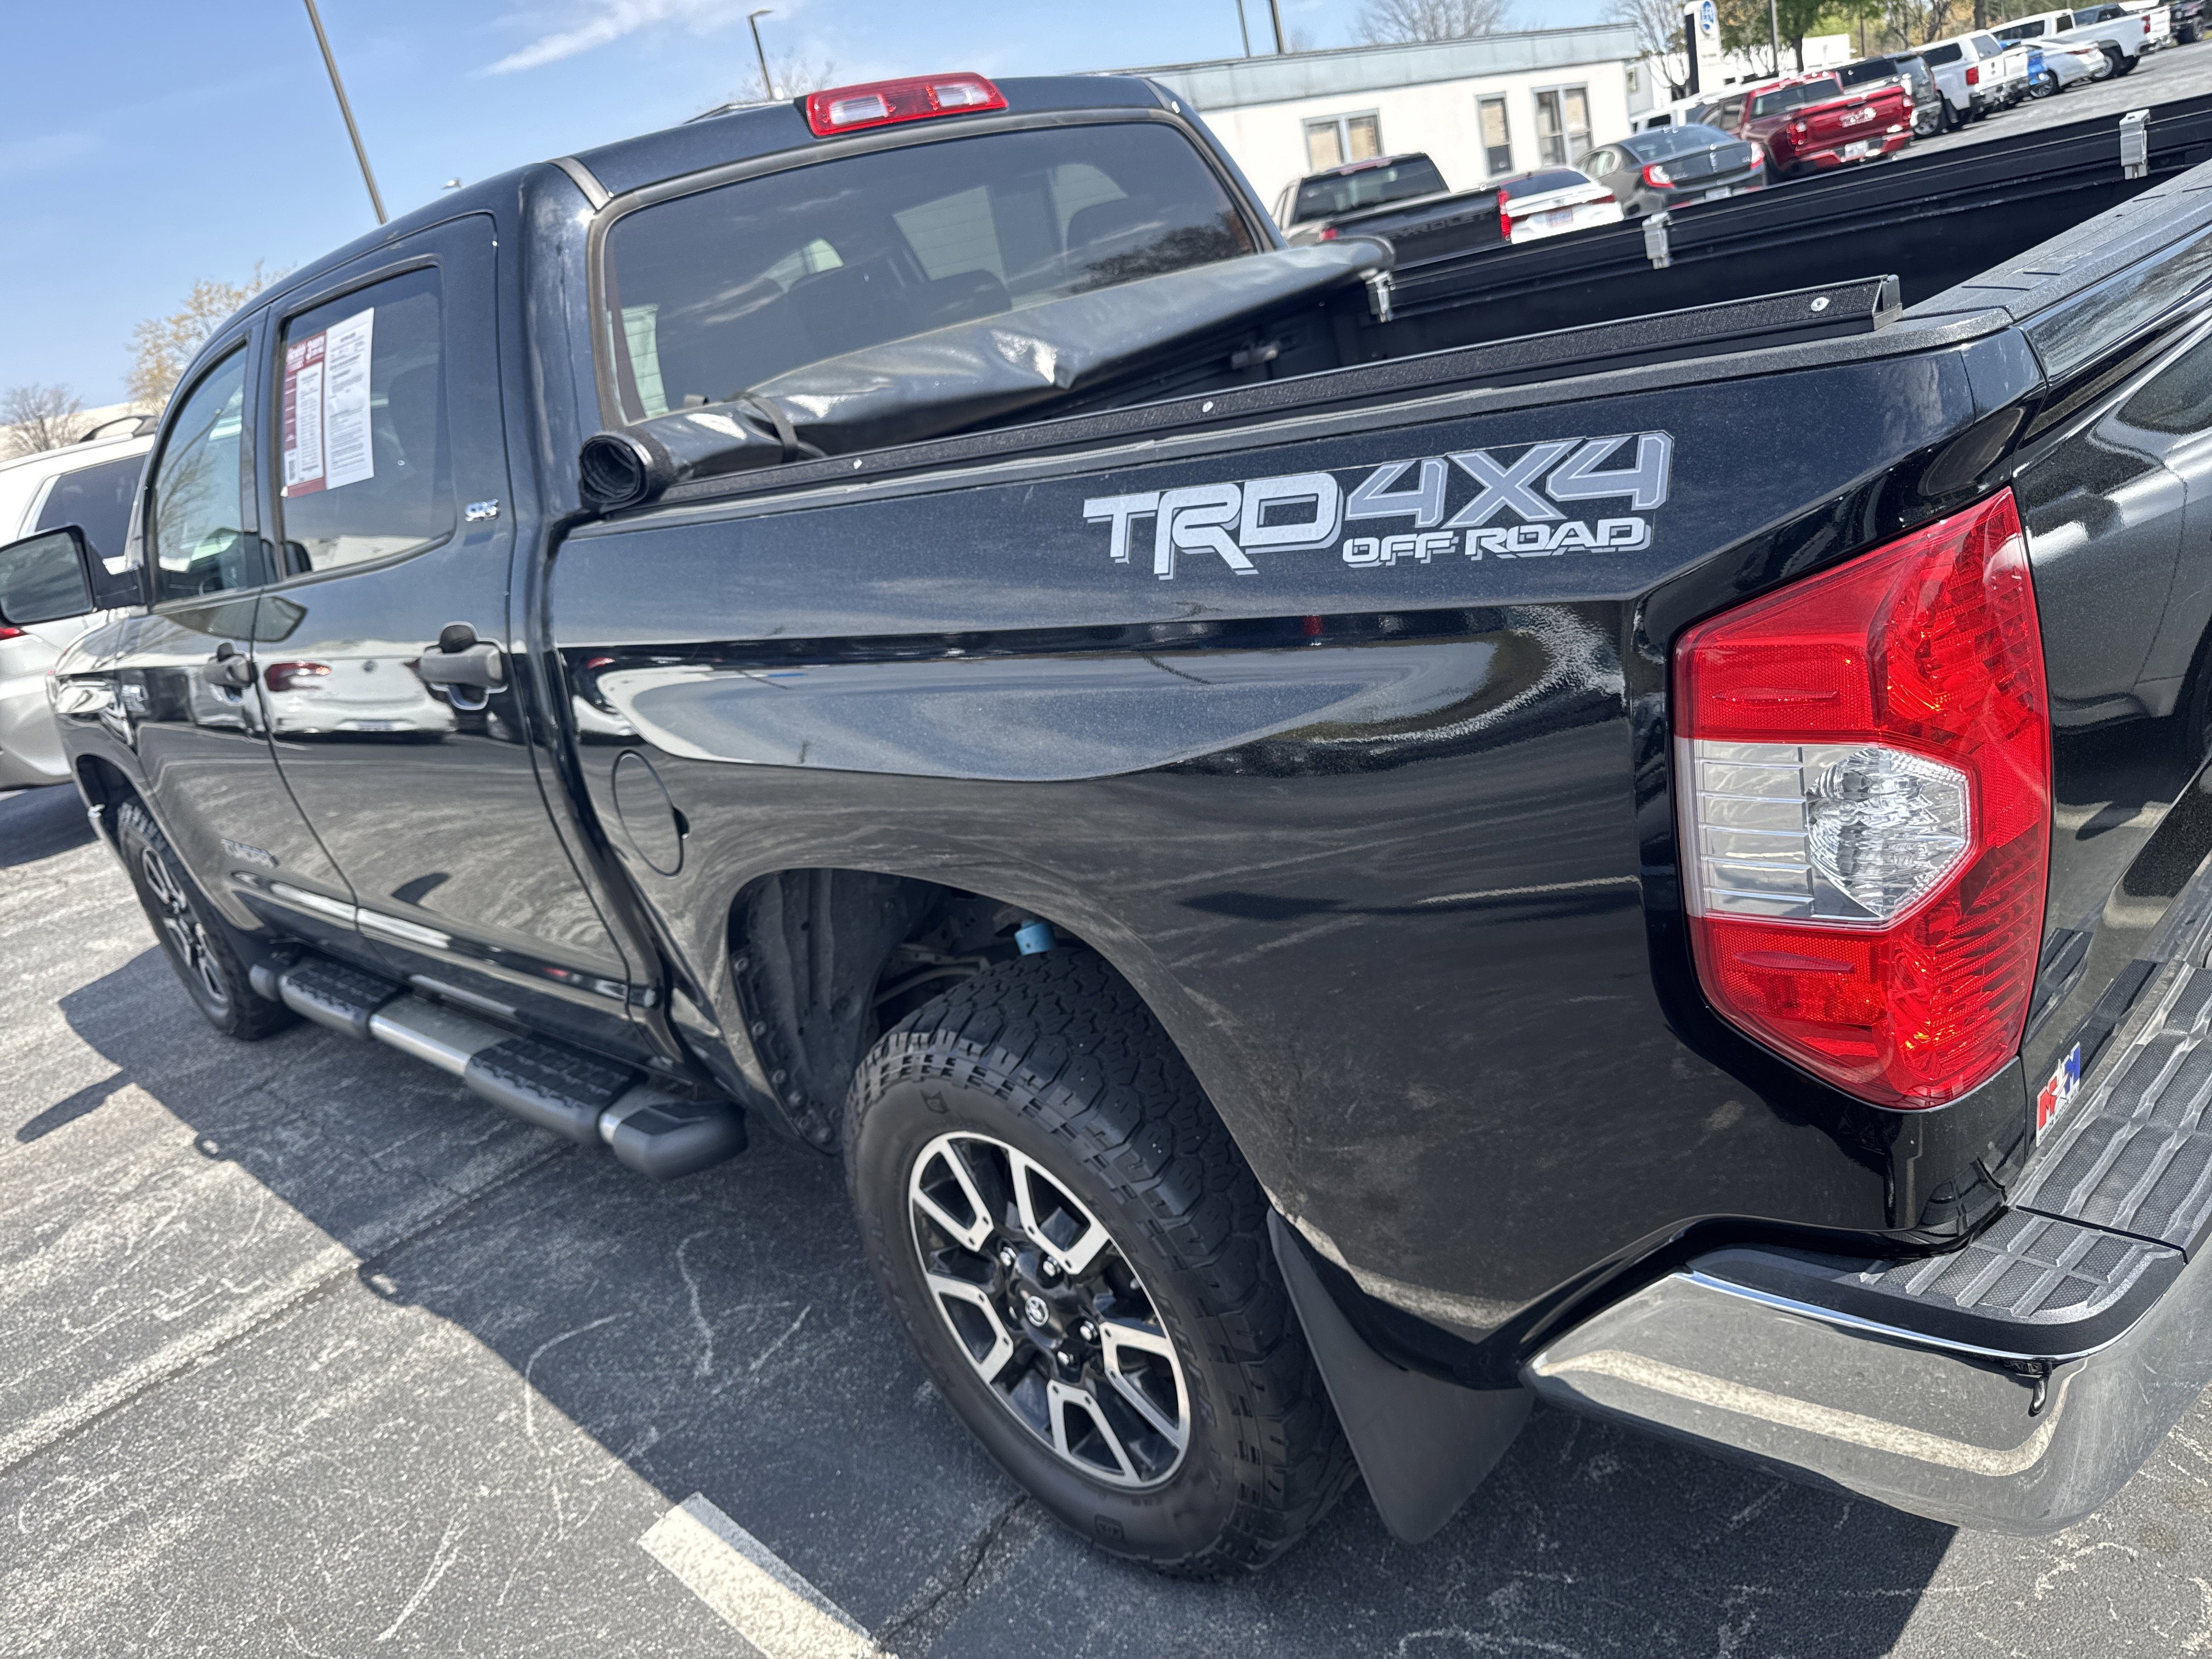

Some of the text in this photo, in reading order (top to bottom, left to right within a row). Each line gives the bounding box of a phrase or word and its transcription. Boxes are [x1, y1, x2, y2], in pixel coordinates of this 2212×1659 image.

[1083, 472, 1342, 579] TRD
[1342, 517, 1652, 567] OFF ROAD
